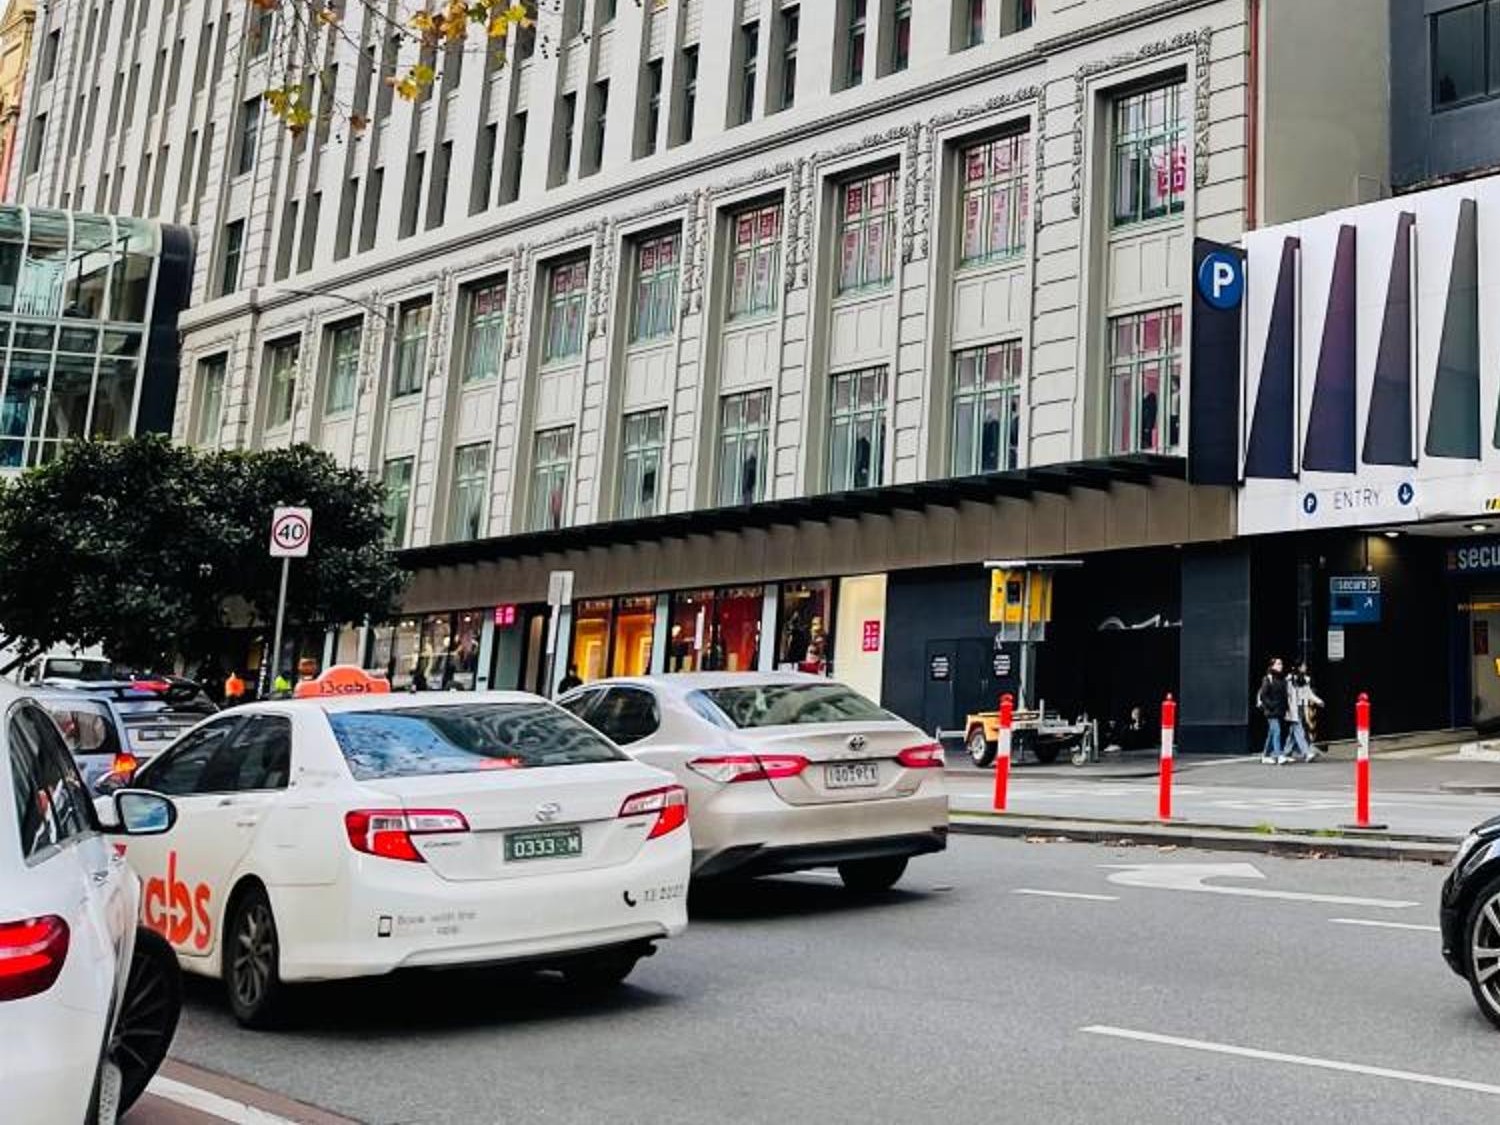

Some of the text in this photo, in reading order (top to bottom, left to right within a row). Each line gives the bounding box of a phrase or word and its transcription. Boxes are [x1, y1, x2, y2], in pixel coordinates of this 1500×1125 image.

[1212, 262, 1235, 298] P
[1333, 488, 1382, 510] ENTRY
[277, 522, 305, 541] 40
[320, 681, 372, 694] 13cabs
